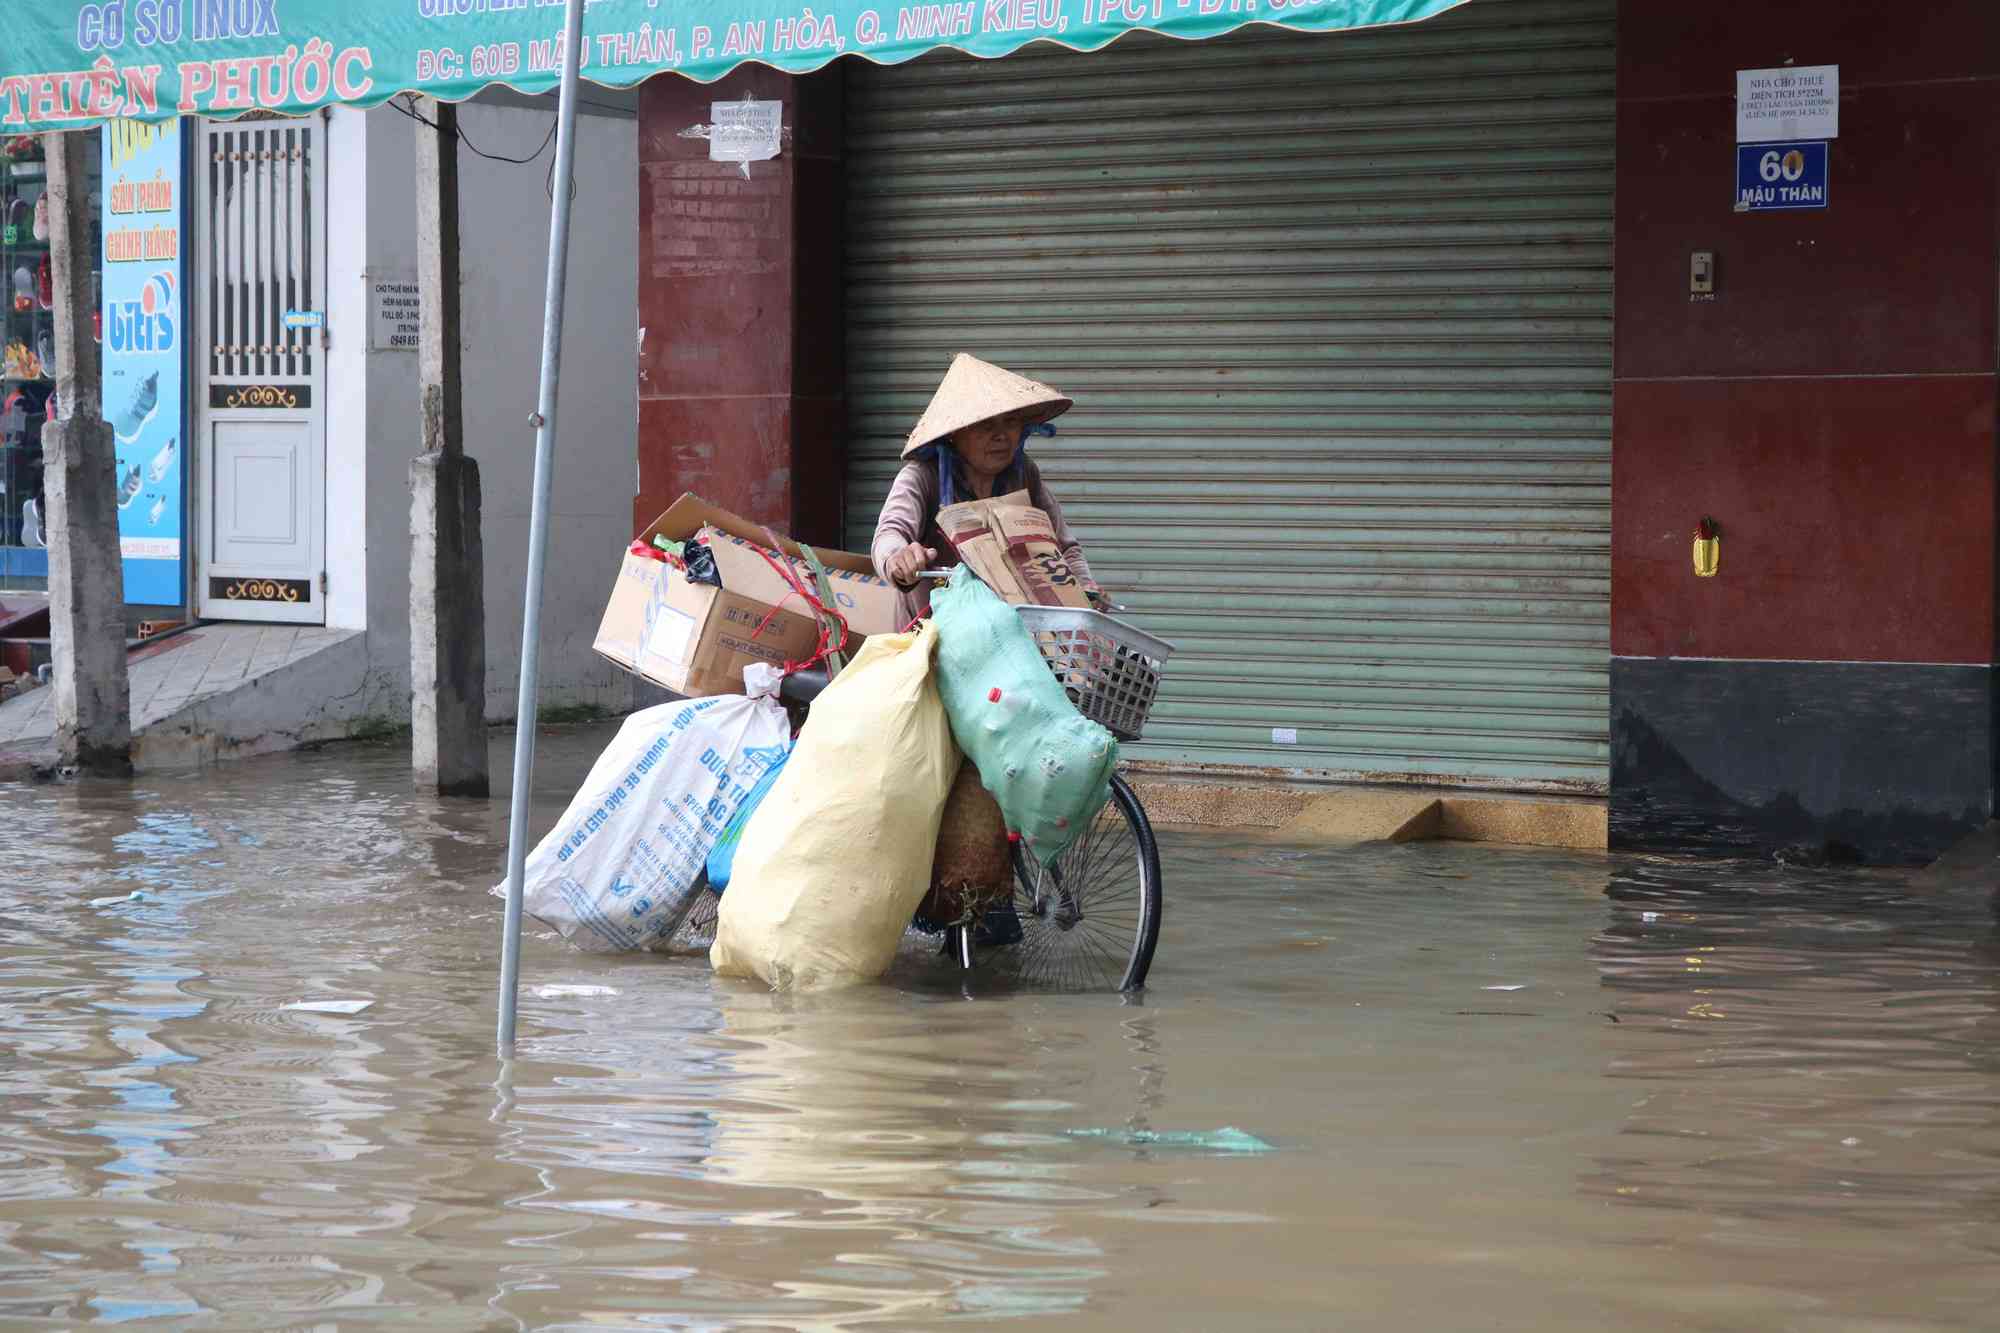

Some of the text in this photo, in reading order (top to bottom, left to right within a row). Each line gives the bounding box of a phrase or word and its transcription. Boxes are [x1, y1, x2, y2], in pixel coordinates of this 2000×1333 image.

[192, 0, 280, 41] INOX
[416, 49, 464, 81] ĐC:
[471, 44, 520, 76] 60B
[597, 22, 683, 66] THÂN,
[692, 26, 714, 59] P.
[722, 20, 766, 56] AN
[773, 8, 846, 53] HÒA,
[855, 10, 887, 46] Q.
[896, 1, 976, 41] NINH
[1, 37, 374, 124] THIÊN PHƯỚC
[1774, 77, 1796, 88] CHO
[1759, 150, 1804, 182] 60
[1742, 183, 1822, 206] MẬU THÂN
